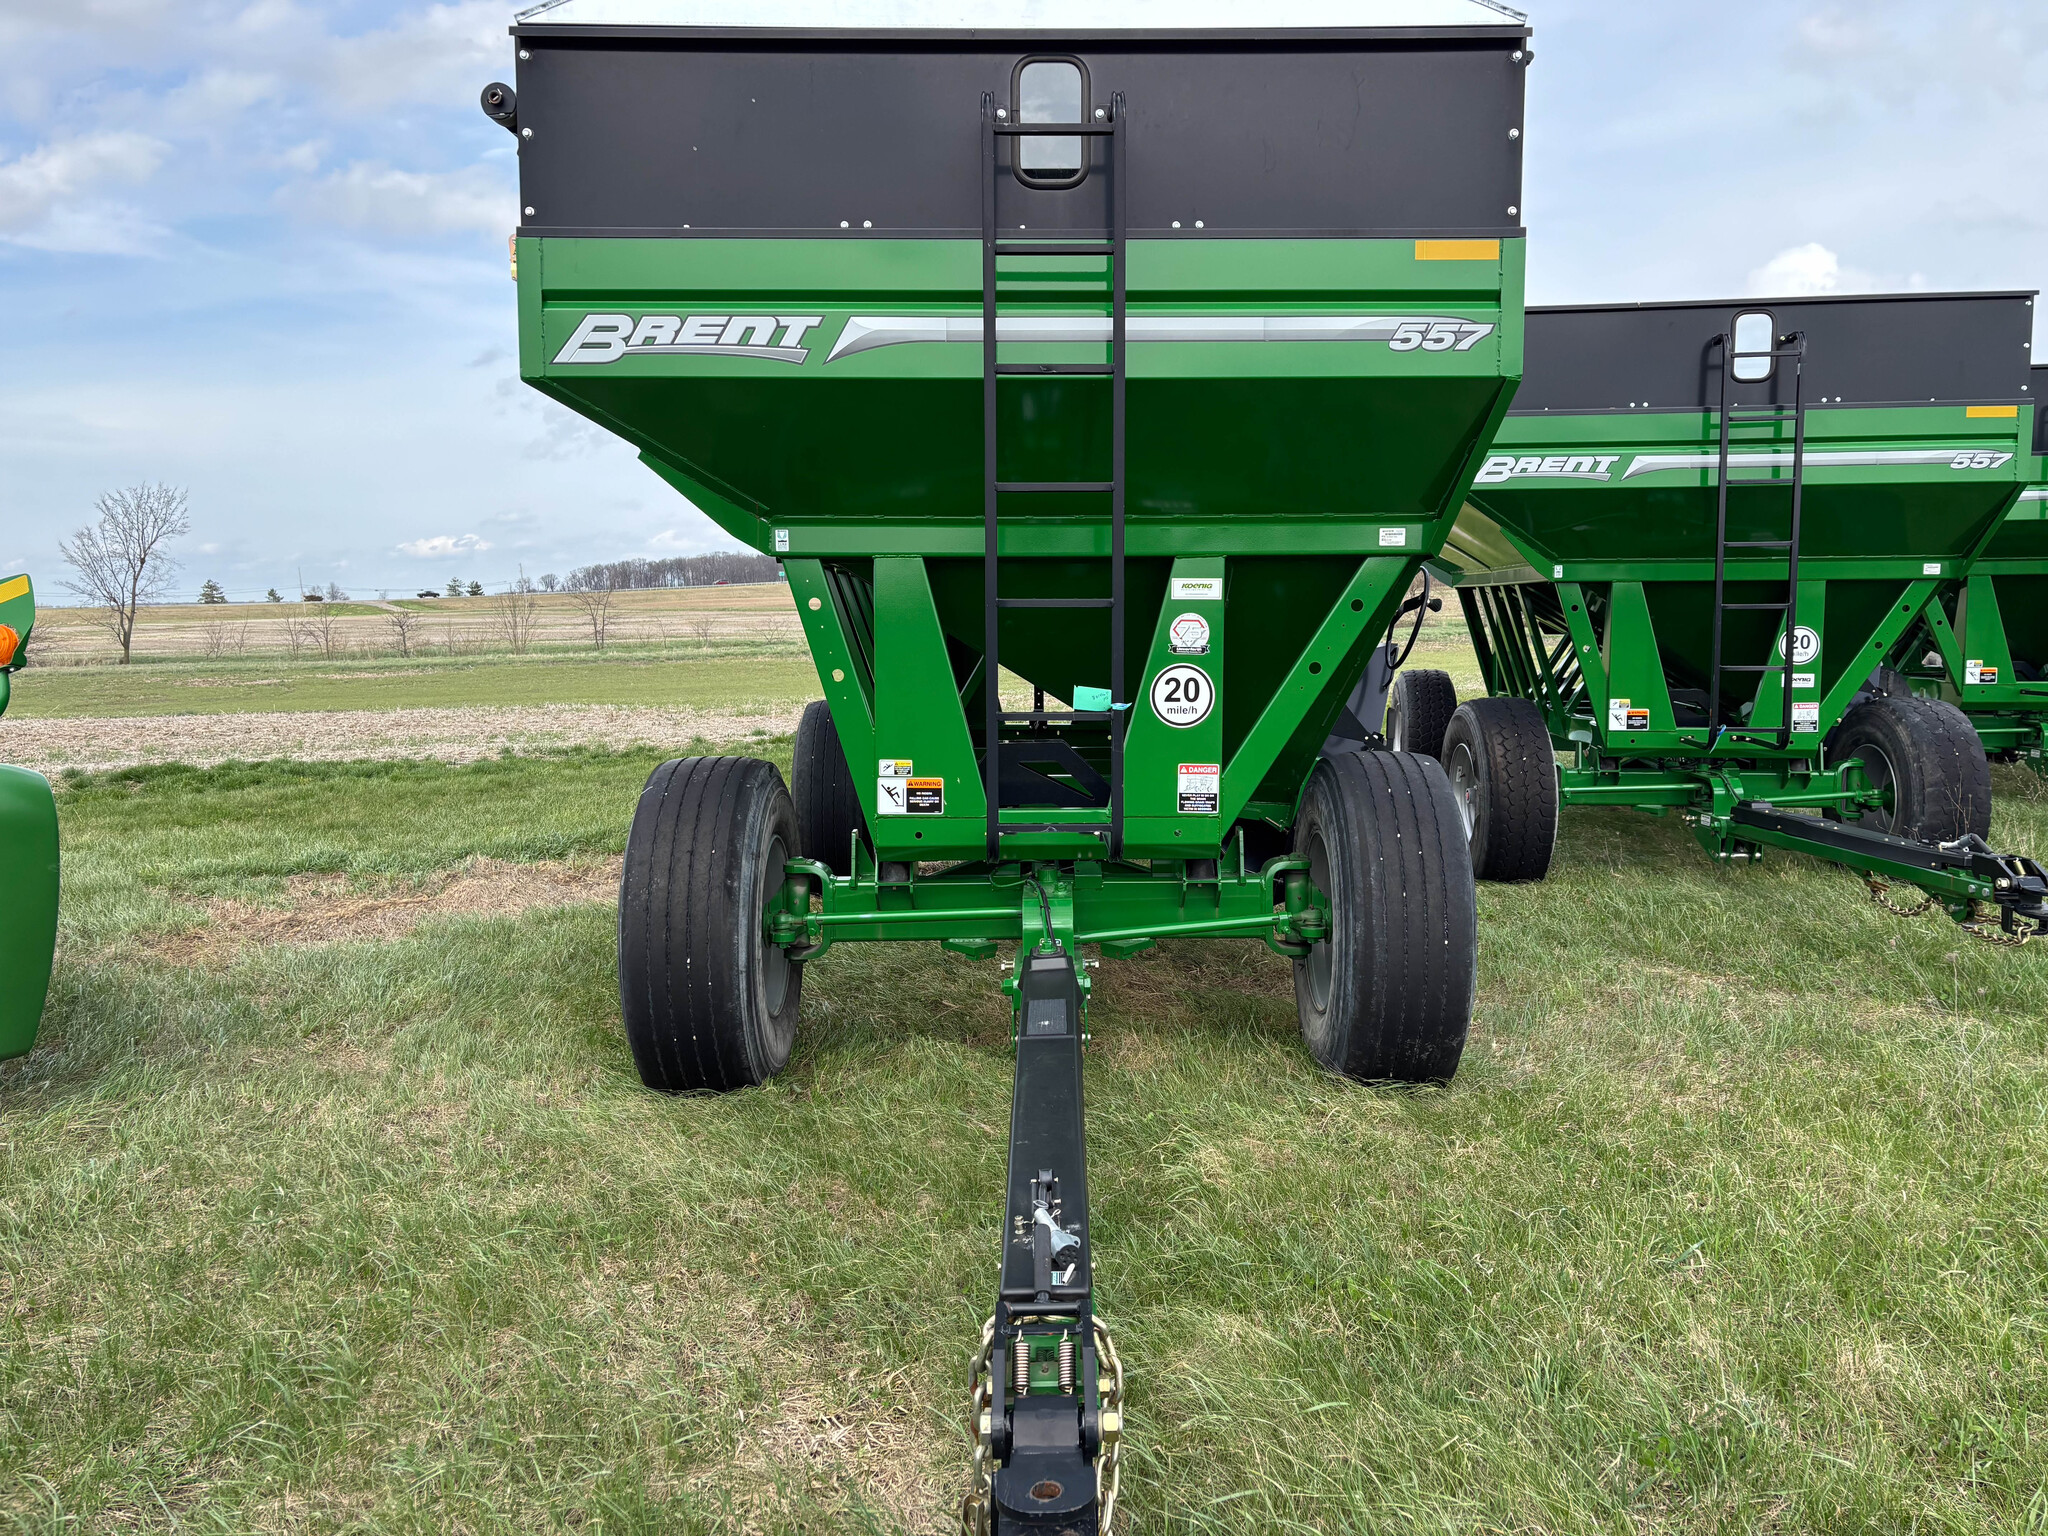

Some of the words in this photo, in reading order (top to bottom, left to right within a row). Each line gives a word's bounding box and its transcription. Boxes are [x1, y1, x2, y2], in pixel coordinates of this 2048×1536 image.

[550, 313, 826, 364] BRENT
[1388, 322, 1496, 352] 557
[1473, 454, 1622, 483] BRENT
[1950, 452, 2014, 470] 557
[1164, 677, 1200, 703] 20
[1167, 706, 1198, 715] mile/h
